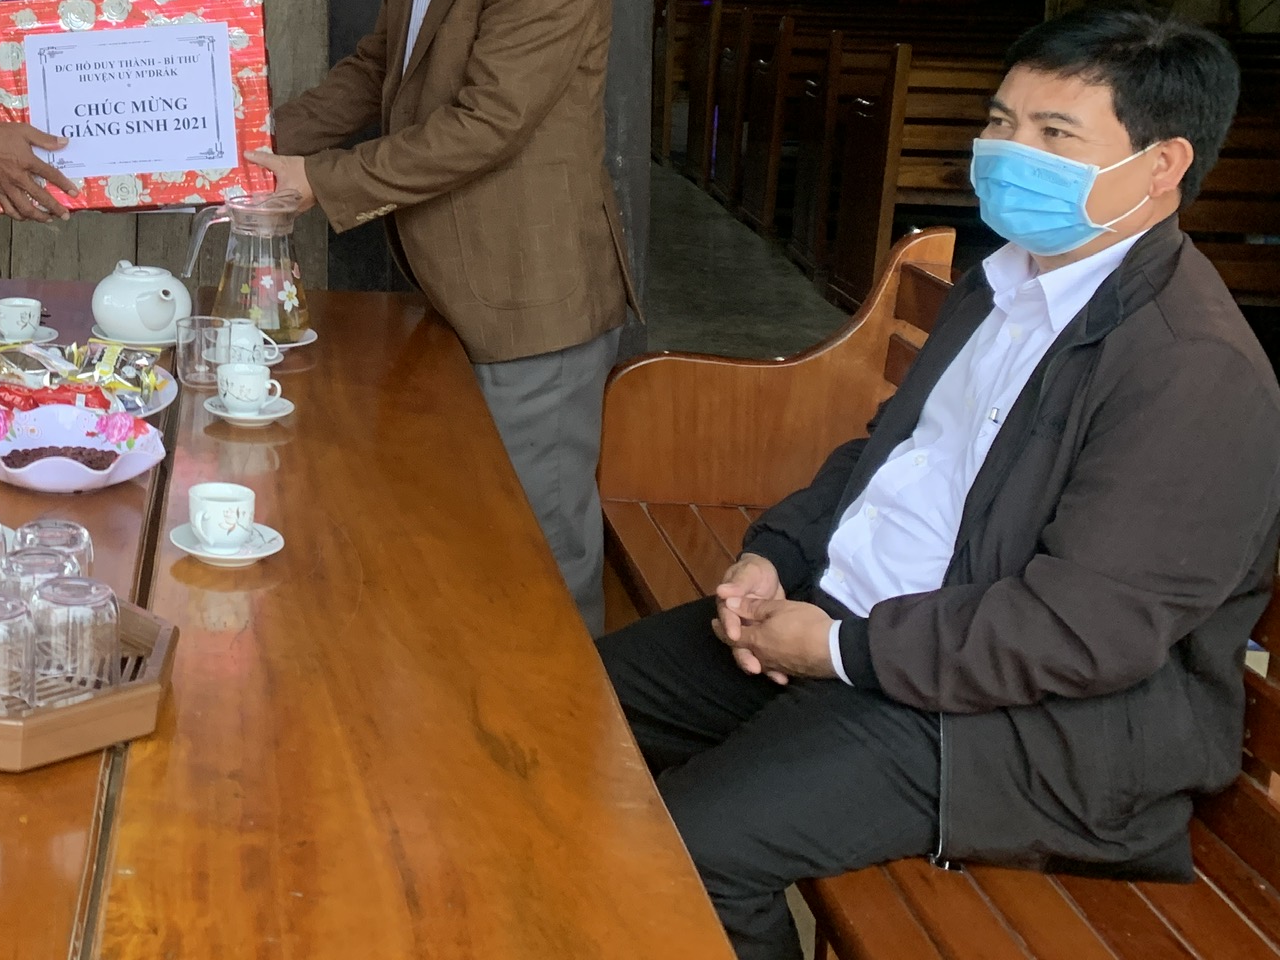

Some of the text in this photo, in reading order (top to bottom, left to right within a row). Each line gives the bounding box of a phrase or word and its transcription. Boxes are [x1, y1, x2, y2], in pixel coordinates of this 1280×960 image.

[55, 64, 73, 72] Đ/C
[94, 61, 115, 70] DUY
[177, 53, 200, 64] THƯ
[79, 71, 115, 83] HUYỆN
[74, 95, 188, 117] CHÚC MỪNG
[61, 116, 207, 138] GIÁNG SINH 2021
